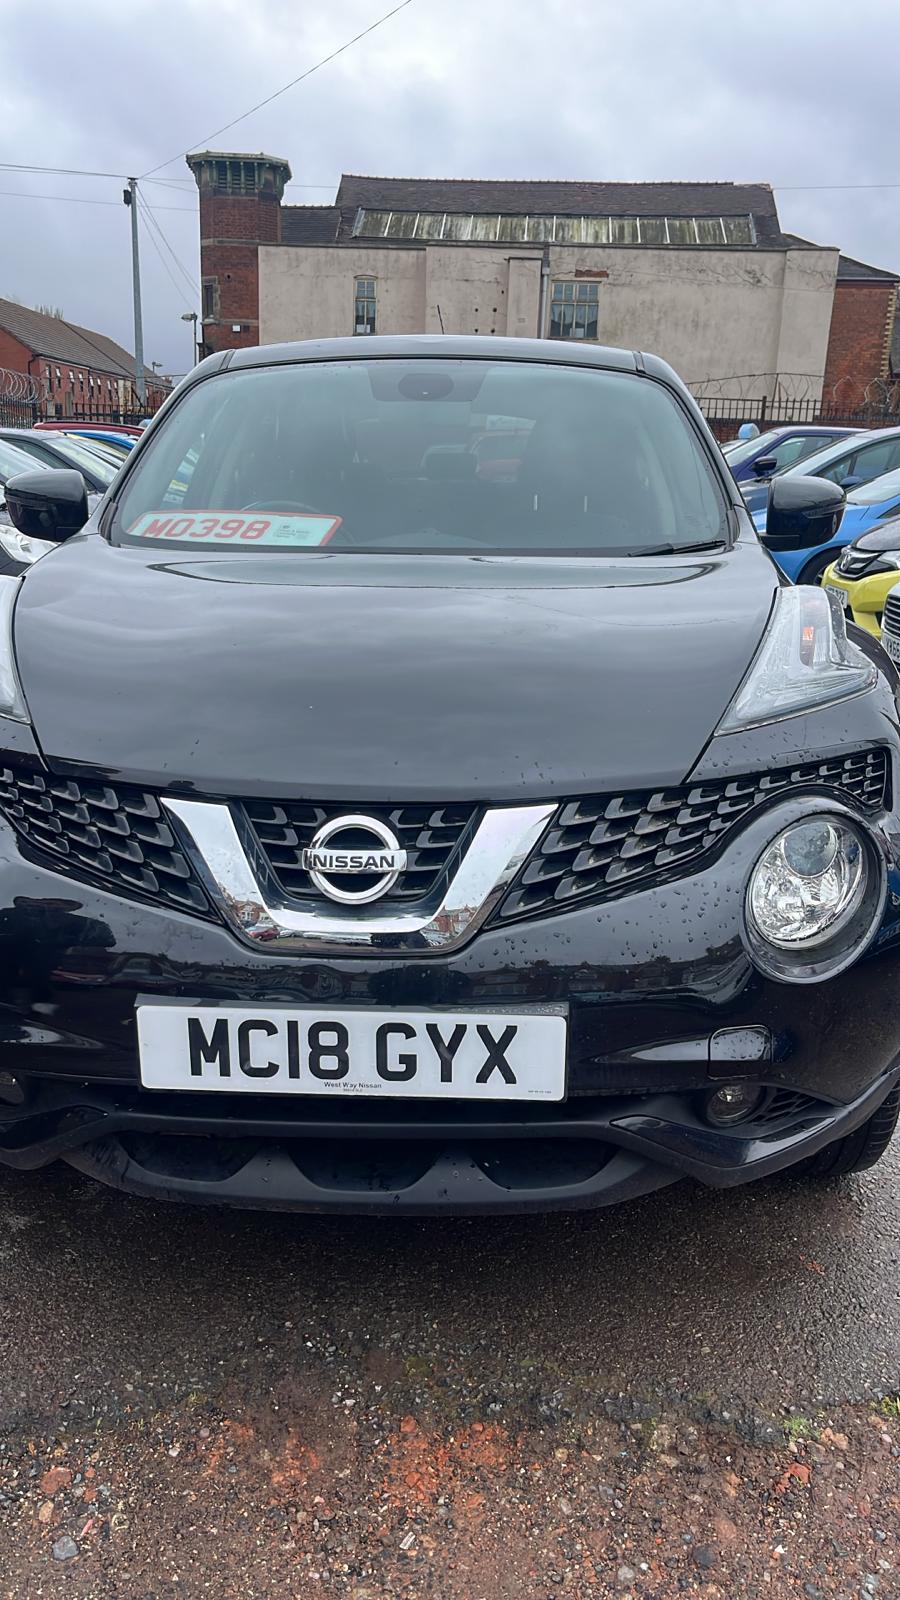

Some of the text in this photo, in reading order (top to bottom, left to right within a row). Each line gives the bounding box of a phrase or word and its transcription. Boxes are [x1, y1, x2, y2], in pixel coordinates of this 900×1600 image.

[312, 853, 395, 869] NISSAN
[187, 1017, 518, 1086] MC18 GYX
